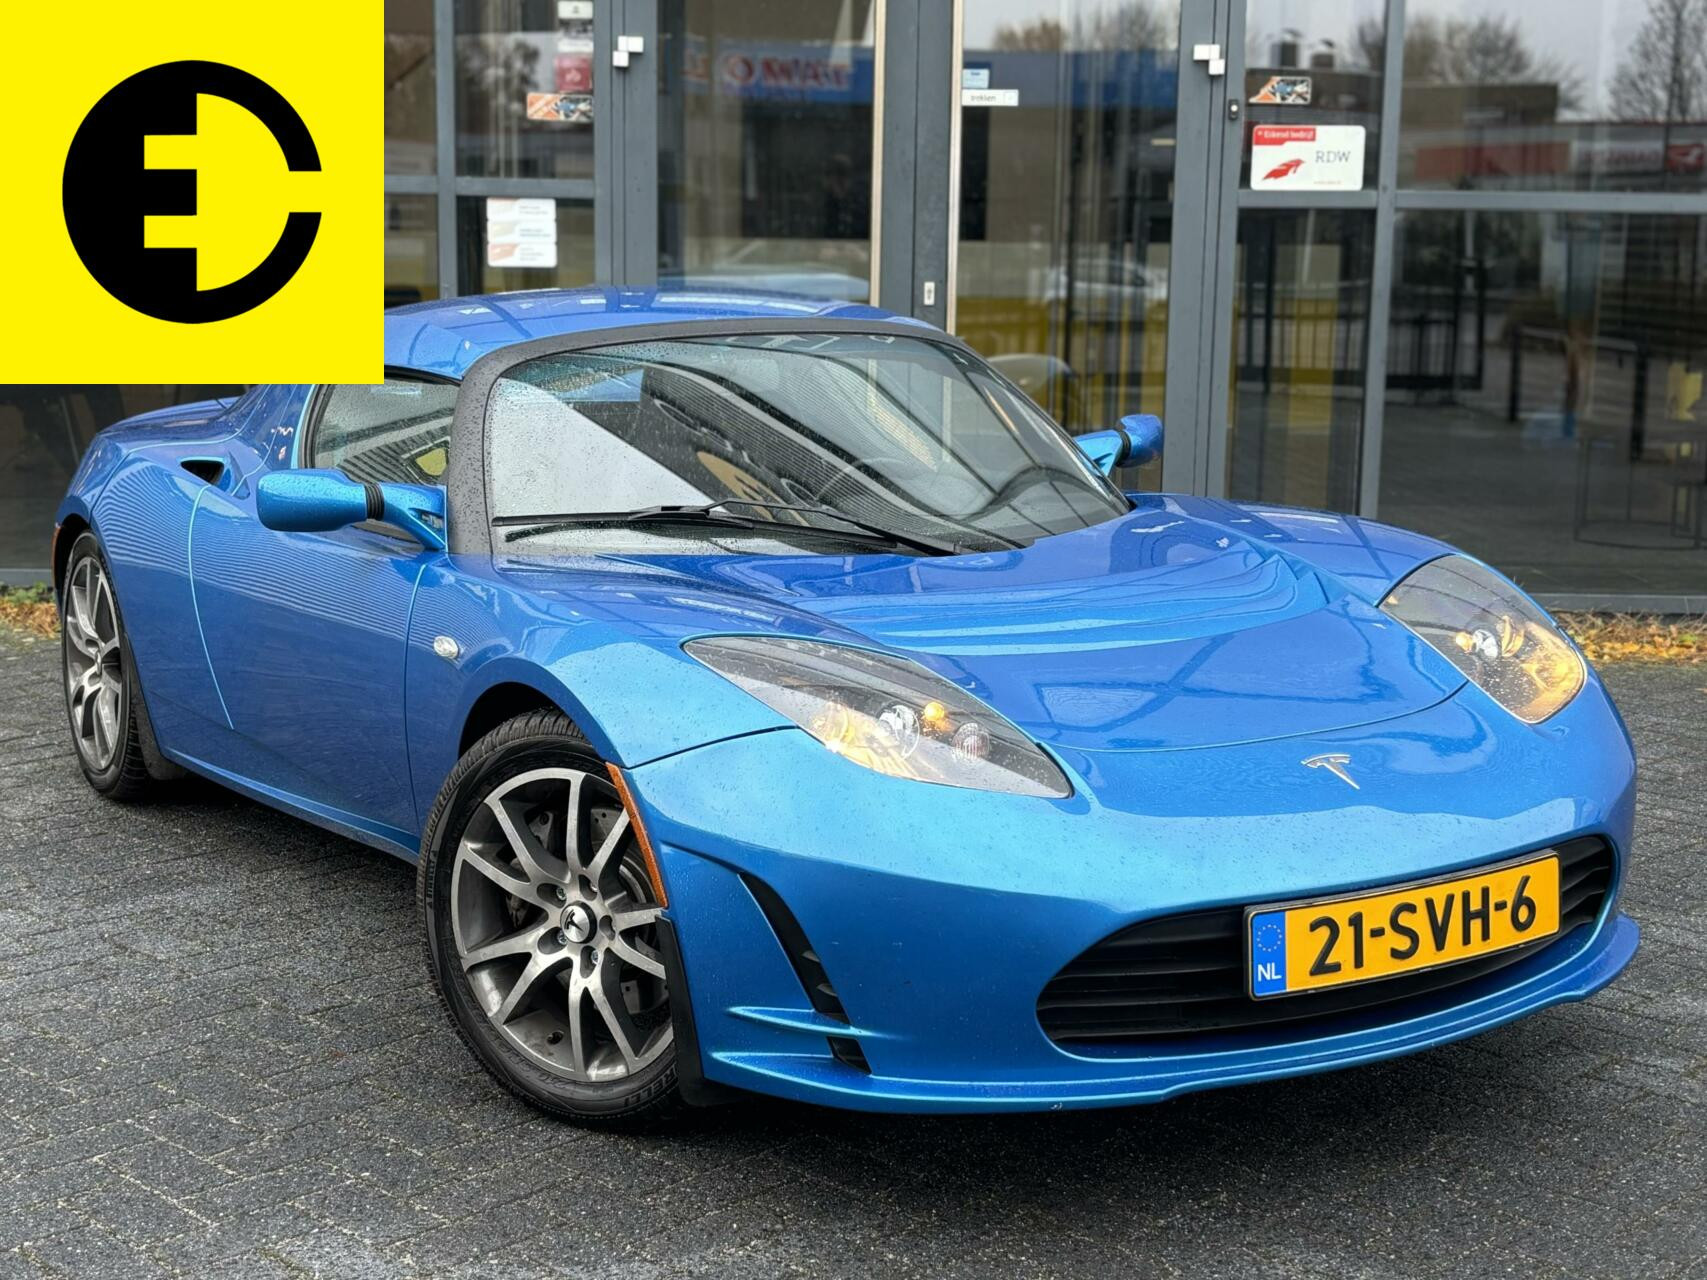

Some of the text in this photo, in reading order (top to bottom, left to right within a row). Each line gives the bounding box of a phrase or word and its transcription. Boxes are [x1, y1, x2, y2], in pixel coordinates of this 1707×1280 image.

[1315, 150, 1352, 163] RDW
[1309, 874, 1537, 977] 21-SVH-6
[1257, 963, 1282, 982] NL
